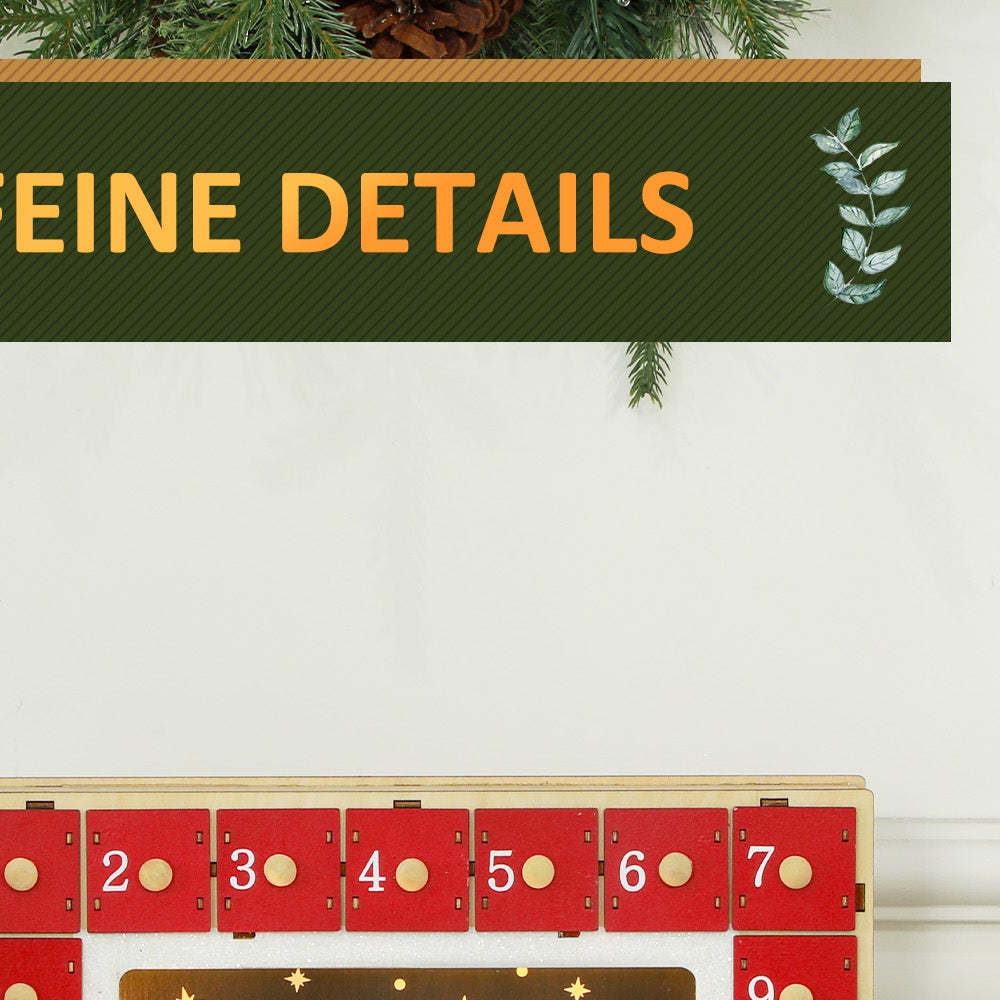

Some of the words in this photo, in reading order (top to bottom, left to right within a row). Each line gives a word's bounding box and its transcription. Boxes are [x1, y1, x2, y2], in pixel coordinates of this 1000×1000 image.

[102, 850, 129, 892] 2
[229, 848, 256, 890] 3
[358, 849, 387, 892] 4
[487, 849, 515, 892] 5
[619, 850, 646, 892] 6
[747, 845, 775, 888] 7
